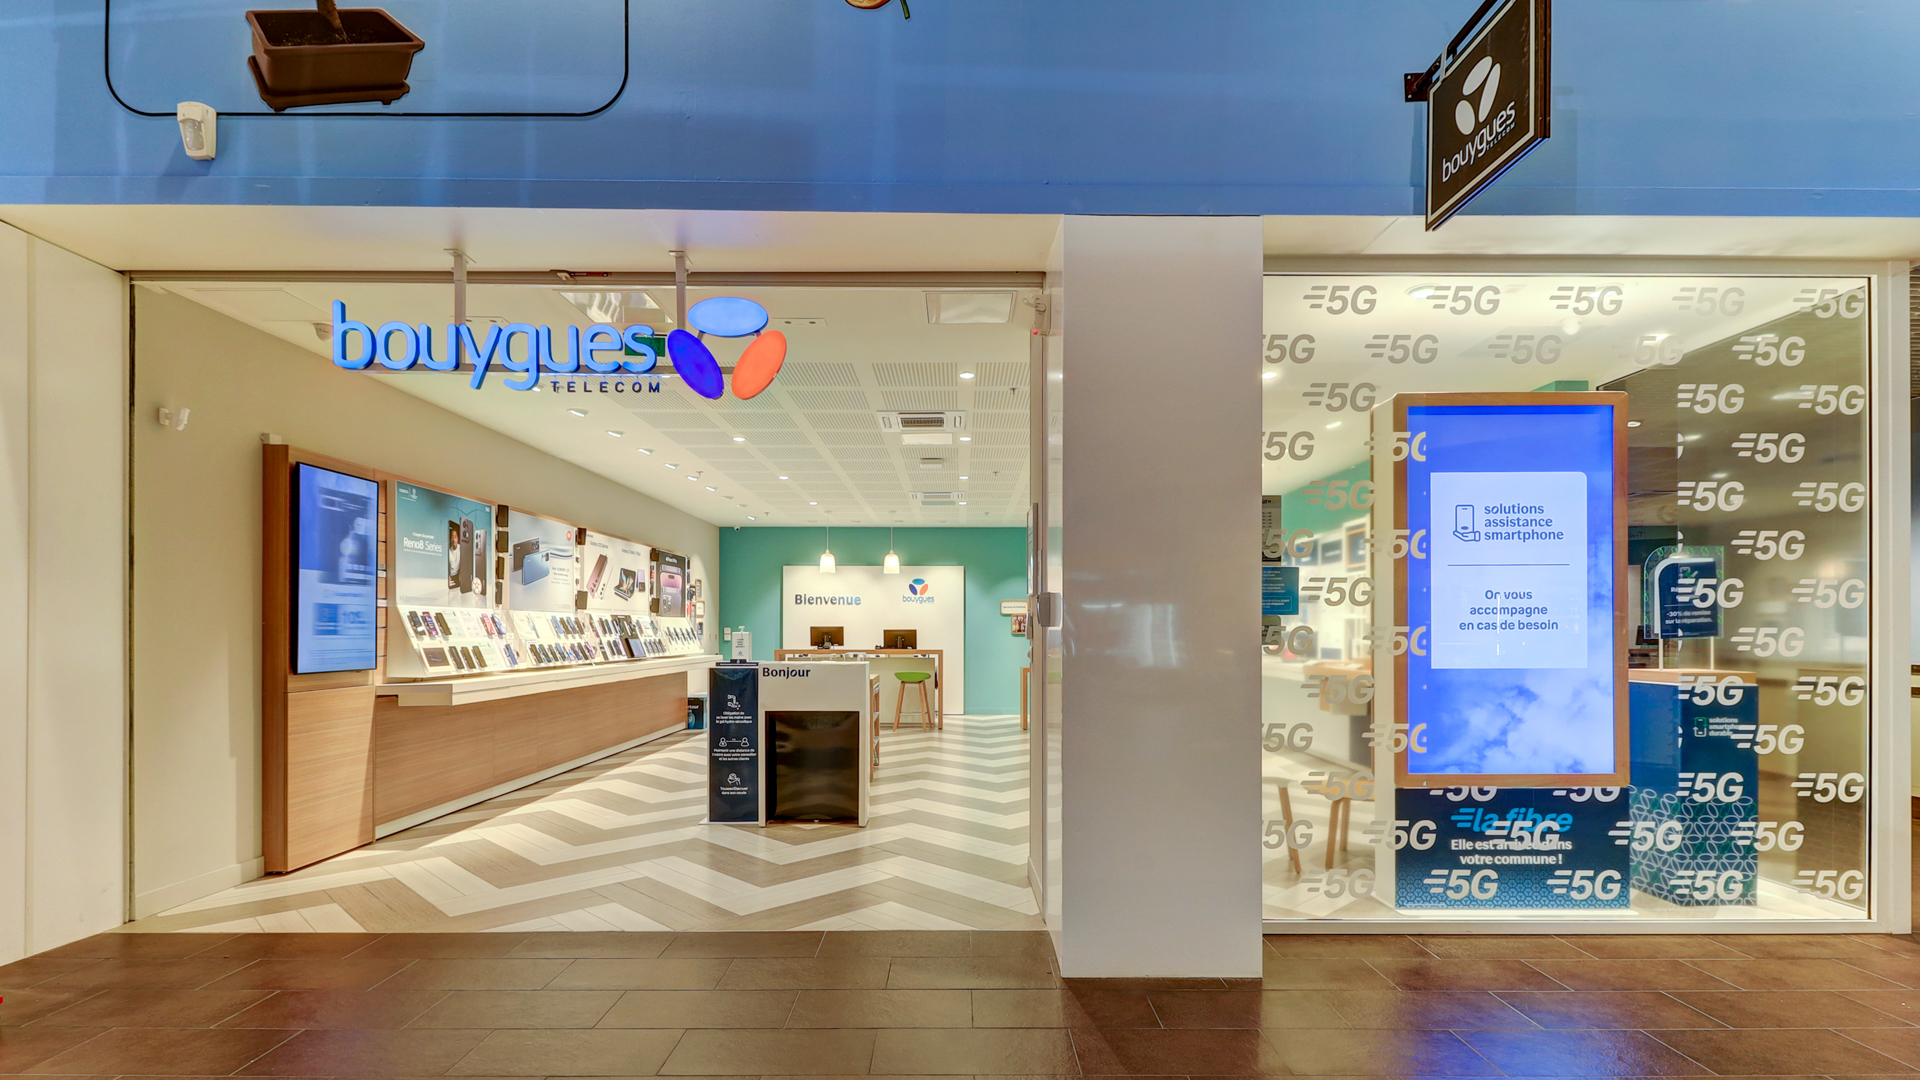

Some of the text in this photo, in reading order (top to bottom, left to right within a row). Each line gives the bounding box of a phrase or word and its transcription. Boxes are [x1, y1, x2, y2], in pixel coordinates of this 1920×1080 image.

[1442, 101, 1516, 182] bouygues
[1486, 122, 1516, 150] TELECOM
[1326, 285, 1377, 315] 5G
[1449, 285, 1500, 315] 5G
[1573, 286, 1623, 316] 5G
[1695, 287, 1745, 317] 5G
[1814, 289, 1865, 318] 5G
[332, 299, 658, 391] bouygues
[1264, 334, 1315, 364] 5G
[1388, 335, 1438, 364] 5G
[1511, 335, 1562, 365] 5G
[1634, 336, 1684, 365] 5G
[1755, 337, 1805, 366] 5G
[551, 381, 661, 393] TELECOM
[1325, 383, 1376, 412] 5G
[1694, 384, 1744, 414] 5G
[1815, 385, 1865, 415] 5G
[1264, 431, 1314, 461] 5G
[1754, 433, 1805, 463] 5G
[1325, 480, 1376, 510] 5G
[1484, 503, 1545, 515] solutions
[1693, 481, 1744, 511] 5G
[1815, 483, 1865, 512] 5G
[1484, 516, 1553, 527] assistance
[1484, 529, 1564, 543] smartphone
[403, 537, 424, 550] Reno8
[425, 540, 442, 553] Series
[1264, 529, 1314, 559] 5G
[1754, 530, 1805, 560] 5G
[795, 594, 861, 605] Bienvenue
[902, 595, 935, 605] bouygues
[1324, 577, 1376, 607] 5G
[1504, 591, 1533, 600] vous
[1692, 578, 1744, 608] 5G
[1814, 579, 1865, 609] 5G
[1459, 619, 1559, 630] en cas de besoin
[1469, 606, 1548, 618] accompagne
[1263, 626, 1314, 655] 5G
[1754, 627, 1805, 657] 5G
[762, 667, 811, 679] Bonjour
[1324, 674, 1375, 704] 5G
[1692, 676, 1743, 706] 5G
[1814, 676, 1865, 706] 5G
[1262, 723, 1313, 752] 5G
[1754, 724, 1804, 755] 5G
[1324, 771, 1375, 801] 5G
[1692, 772, 1744, 803] 5G
[1814, 773, 1865, 803] 5G
[1263, 819, 1313, 850] 5G
[1473, 807, 1573, 832] la fibre
[1385, 820, 1437, 850] 5G
[1451, 838, 1474, 850] Elle
[1475, 839, 1494, 850] est
[1510, 820, 1560, 851] 5G
[1631, 821, 1683, 851] 5G
[1754, 821, 1805, 851] 5G
[1460, 855, 1493, 865] votre
[1494, 855, 1556, 865] commune
[1324, 869, 1375, 899] 5G
[1446, 869, 1498, 900] 5G
[1570, 870, 1622, 900] 5G
[1692, 870, 1744, 901] 5G
[1813, 870, 1864, 900] 5G
